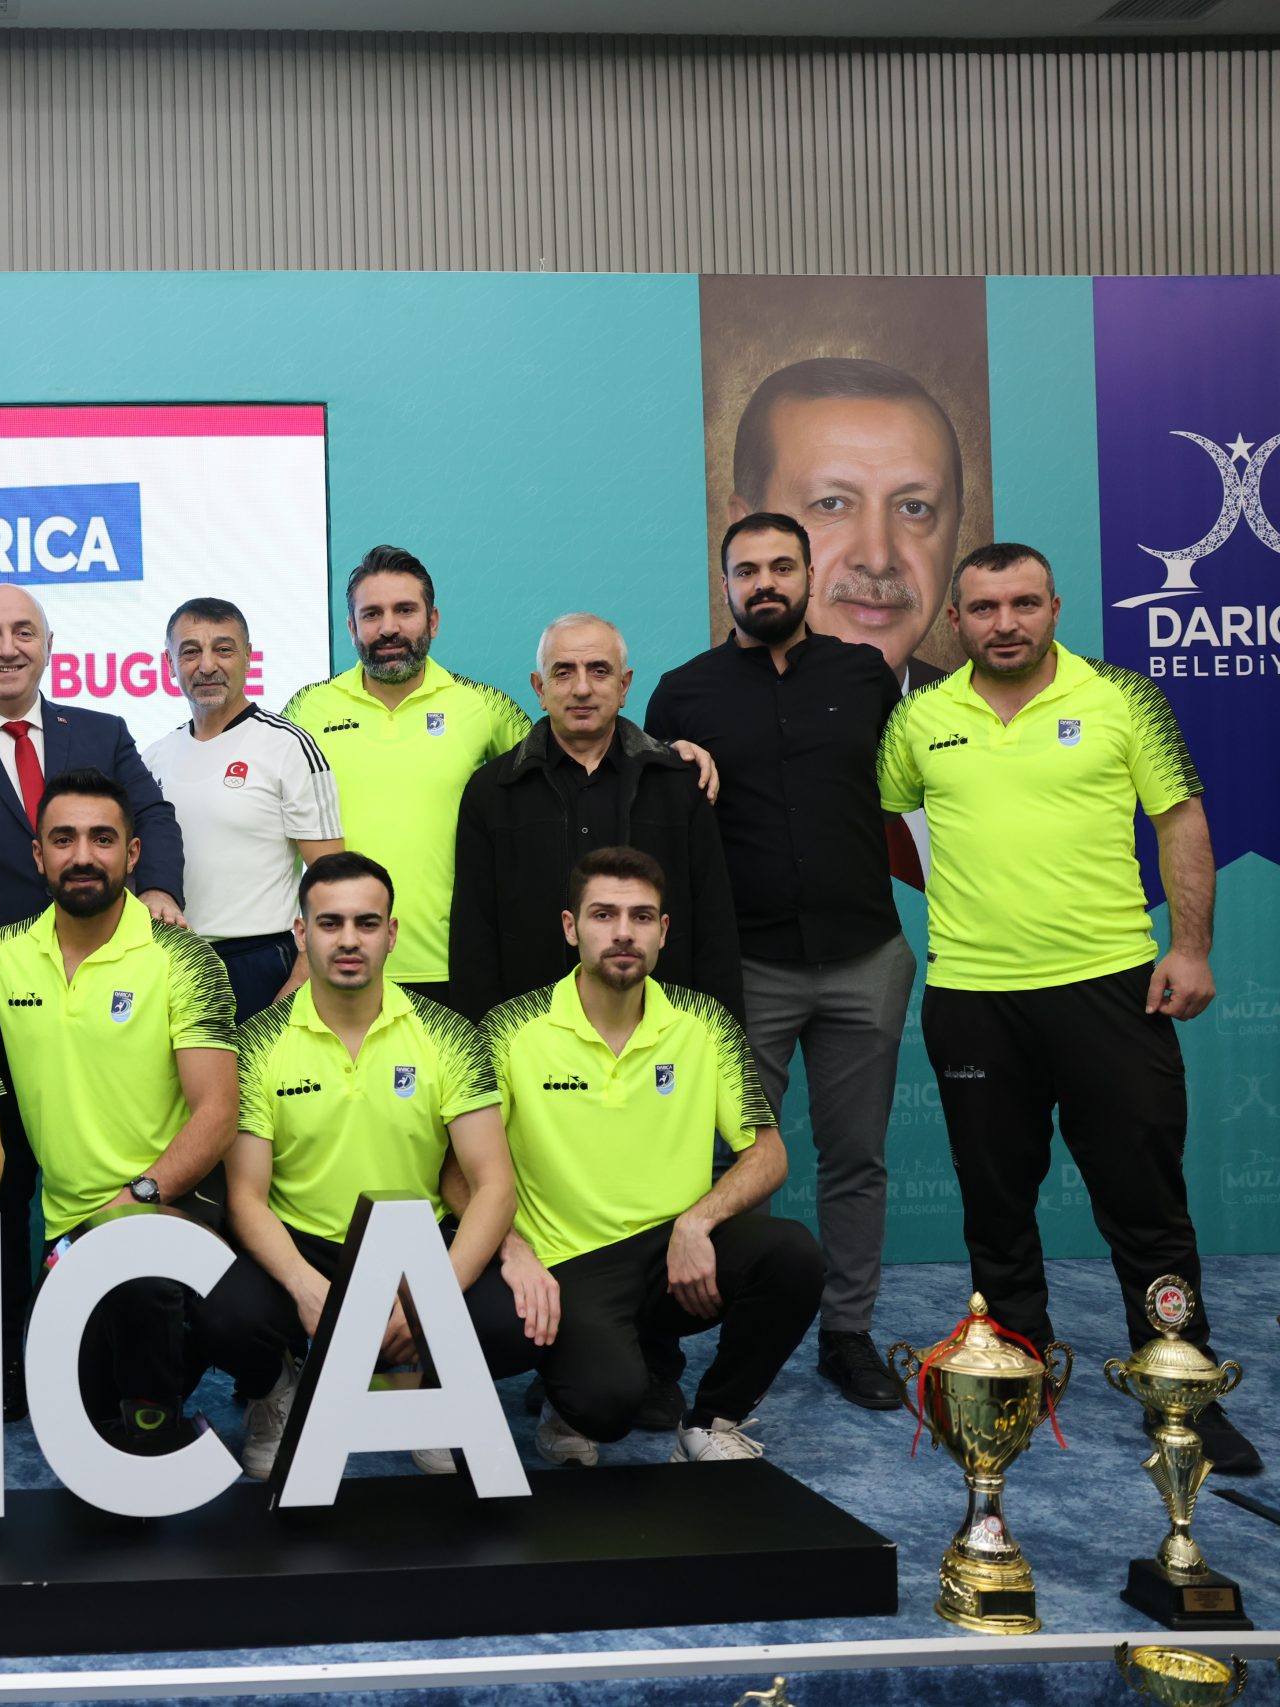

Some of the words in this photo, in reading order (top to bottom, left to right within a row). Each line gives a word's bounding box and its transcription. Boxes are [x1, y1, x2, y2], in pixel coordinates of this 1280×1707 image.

[50, 650, 264, 699] BUGE
[323, 718, 360, 734] diadora
[928, 733, 969, 751] diadora
[8, 992, 43, 1007] diadora
[276, 1078, 322, 1097] diadora
[543, 1074, 588, 1091] diadora
